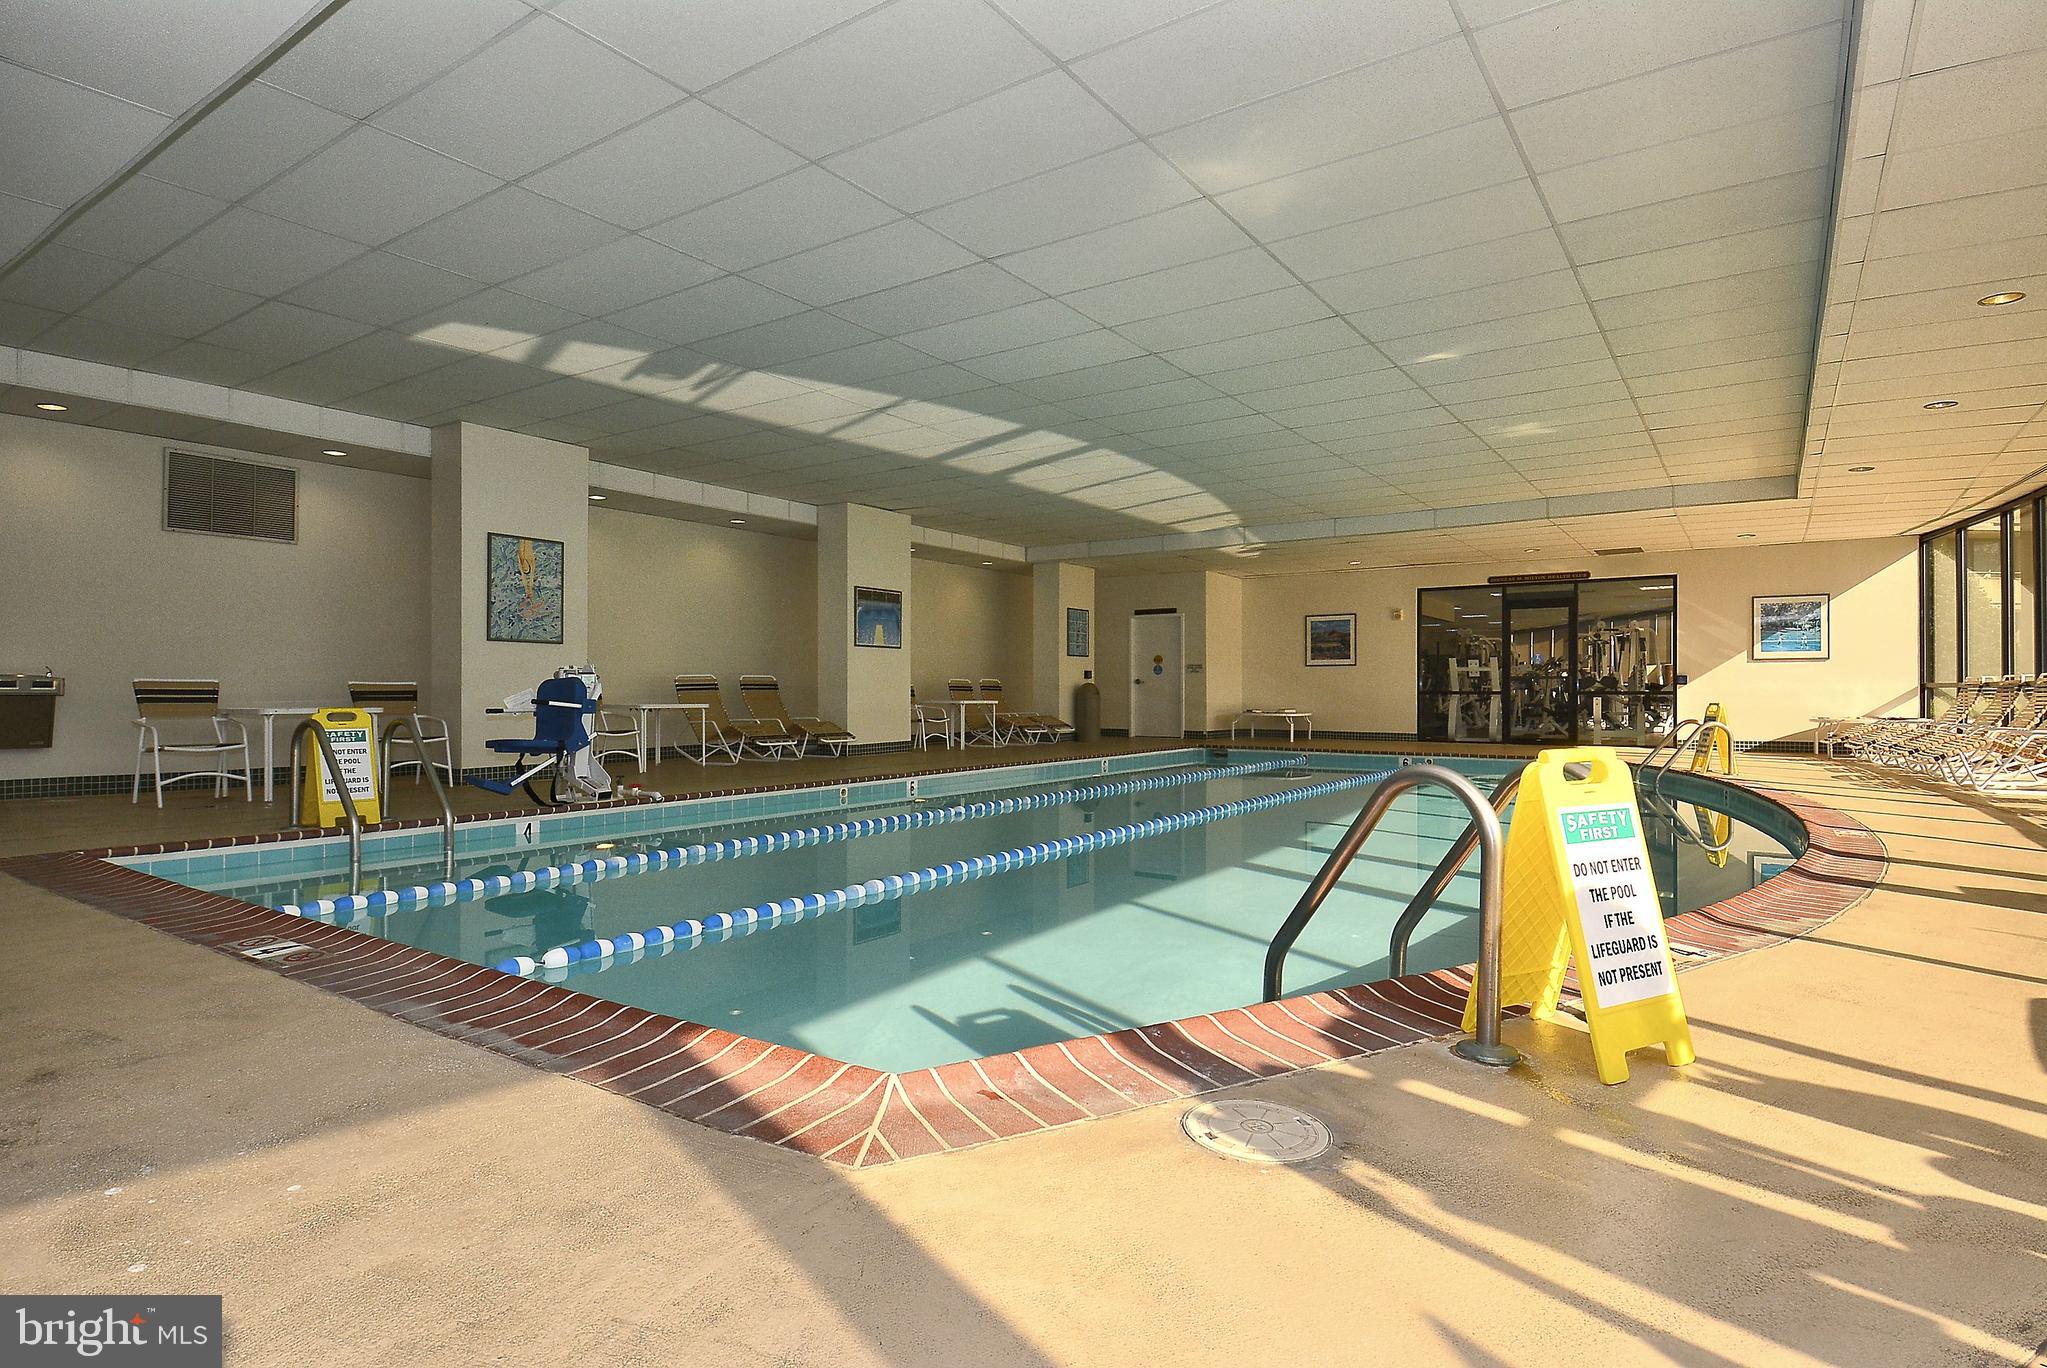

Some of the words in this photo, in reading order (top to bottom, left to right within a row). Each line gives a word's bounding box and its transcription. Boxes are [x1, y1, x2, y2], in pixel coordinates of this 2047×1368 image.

[1567, 811, 1628, 833] SAFETY
[1579, 825, 1619, 841] FIRST
[1573, 862, 1588, 877] DO
[1589, 860, 1609, 876] NOT
[1611, 856, 1642, 873] ENTER
[1589, 887, 1610, 903] THE
[1610, 884, 1637, 900] POOL
[1603, 914, 1614, 929] IF
[1613, 911, 1635, 927] THE
[1591, 936, 1647, 959] LIFEGUARD
[1647, 934, 1659, 949] IS
[1598, 968, 1618, 987] NOT
[1619, 961, 1663, 983] PRESENT
